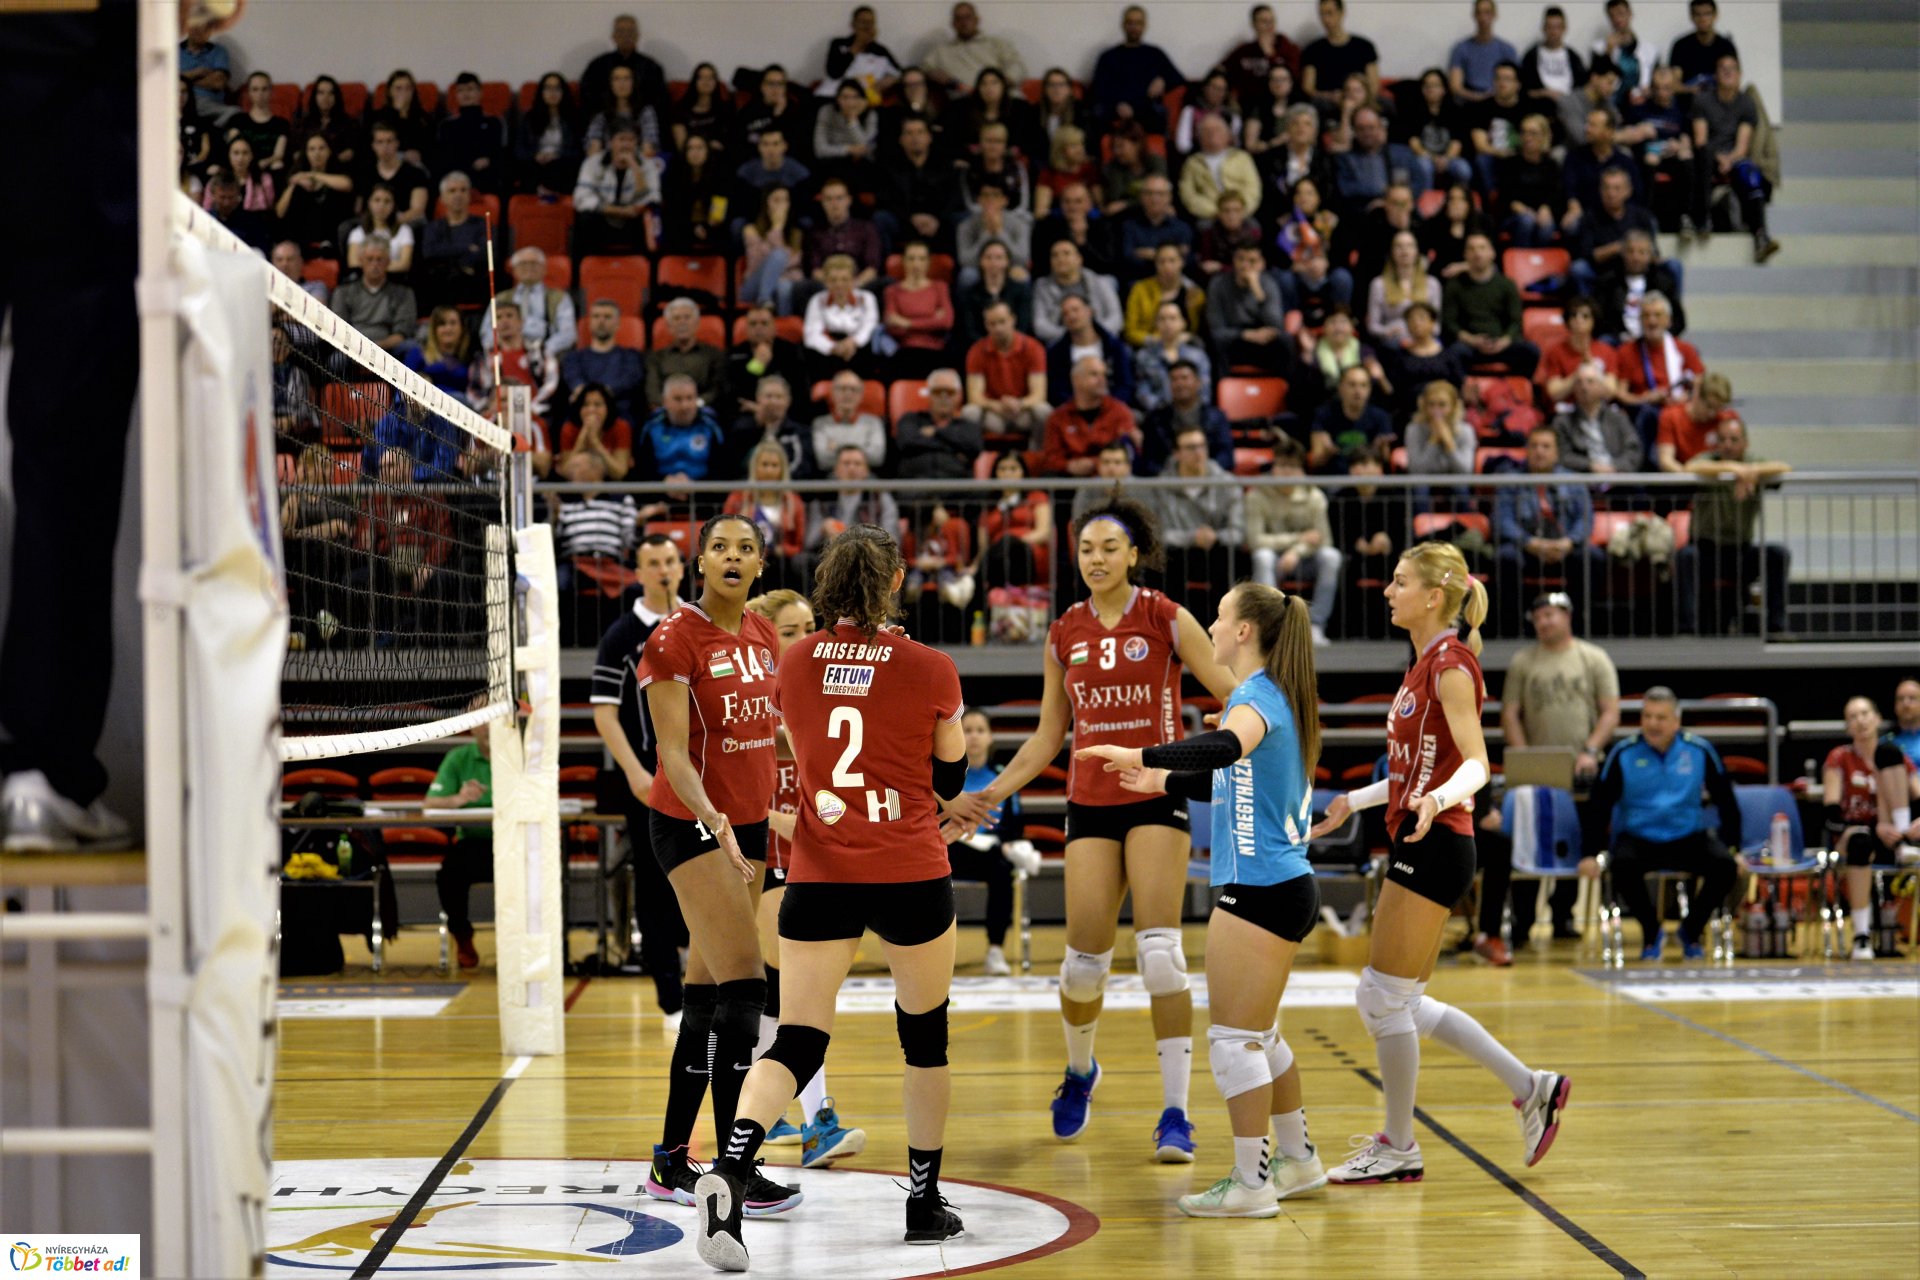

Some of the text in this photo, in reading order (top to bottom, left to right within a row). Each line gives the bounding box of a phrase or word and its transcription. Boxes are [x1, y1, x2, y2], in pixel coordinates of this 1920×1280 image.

[812, 642, 893, 662] BRISEBOIS
[1099, 637, 1116, 670] 3
[732, 645, 765, 684] 14
[825, 667, 872, 684] FATUM
[823, 683, 868, 696] NYÍREGYHÁZA
[827, 706, 864, 787] 2
[1232, 757, 1256, 857] NYÍREGYHÁZA
[695, 817, 716, 842] 1
[1394, 861, 1414, 875] JAKO
[1219, 895, 1237, 905] AKO
